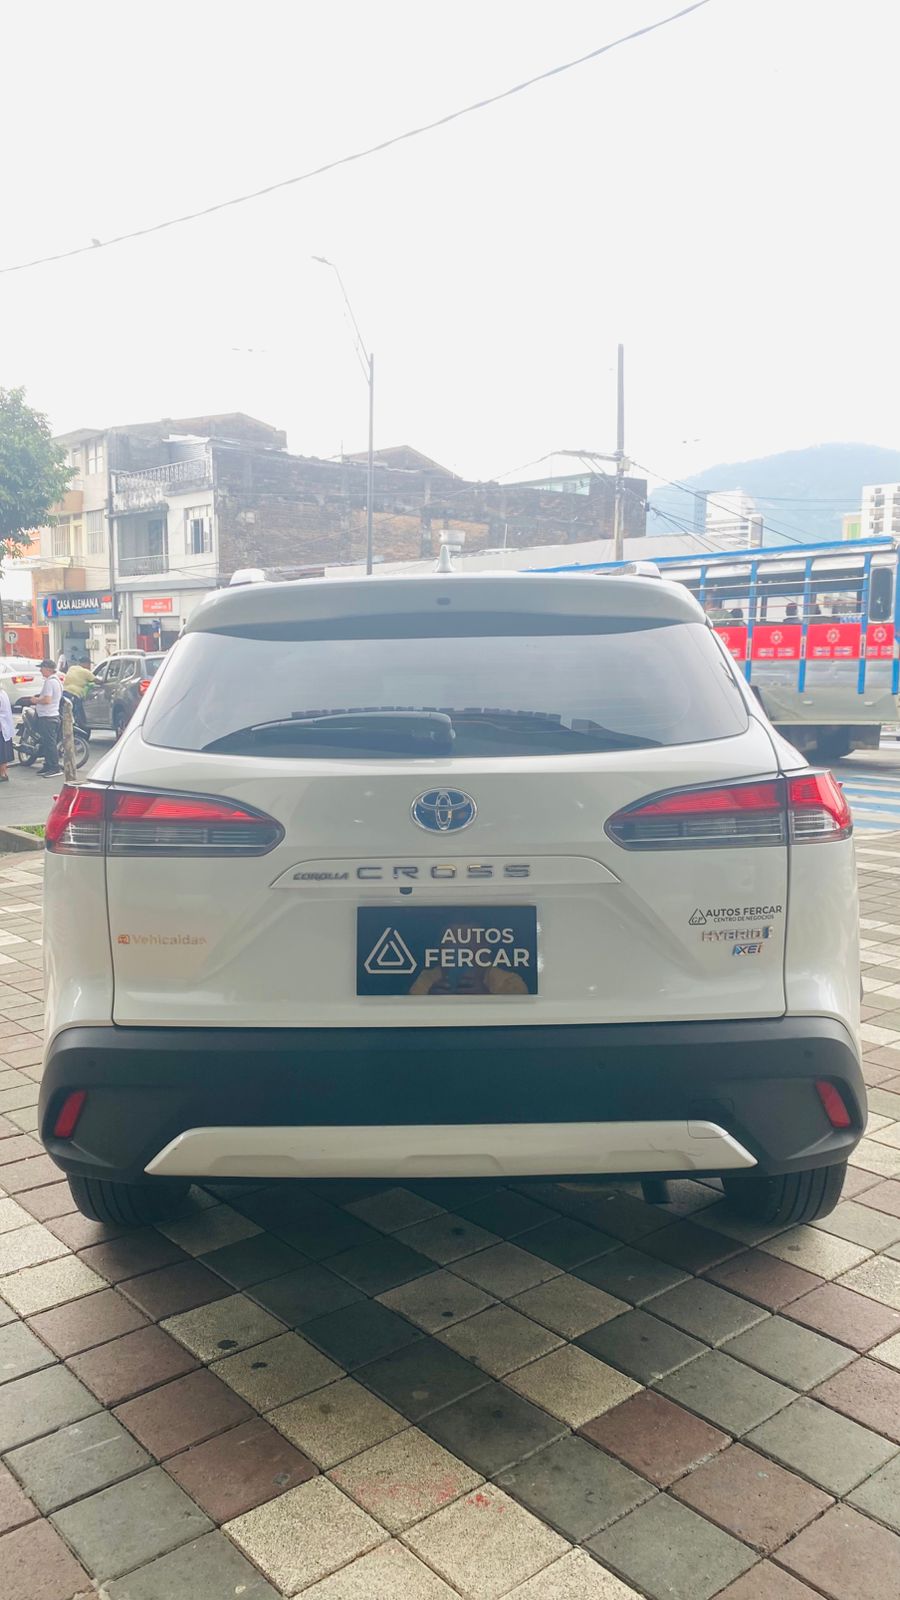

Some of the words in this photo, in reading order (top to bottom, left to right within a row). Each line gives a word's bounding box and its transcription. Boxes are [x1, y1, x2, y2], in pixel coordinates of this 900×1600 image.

[57, 600, 70, 610] CASA
[72, 598, 99, 609] ALEMANA
[293, 872, 349, 881] COROLLA
[357, 864, 530, 880] CROSS
[706, 908, 740, 917] AUTOS
[744, 905, 782, 915] FERCAR
[441, 928, 515, 944] AUTOS
[702, 929, 760, 941] HYBRID
[425, 949, 530, 968] FERCAR
